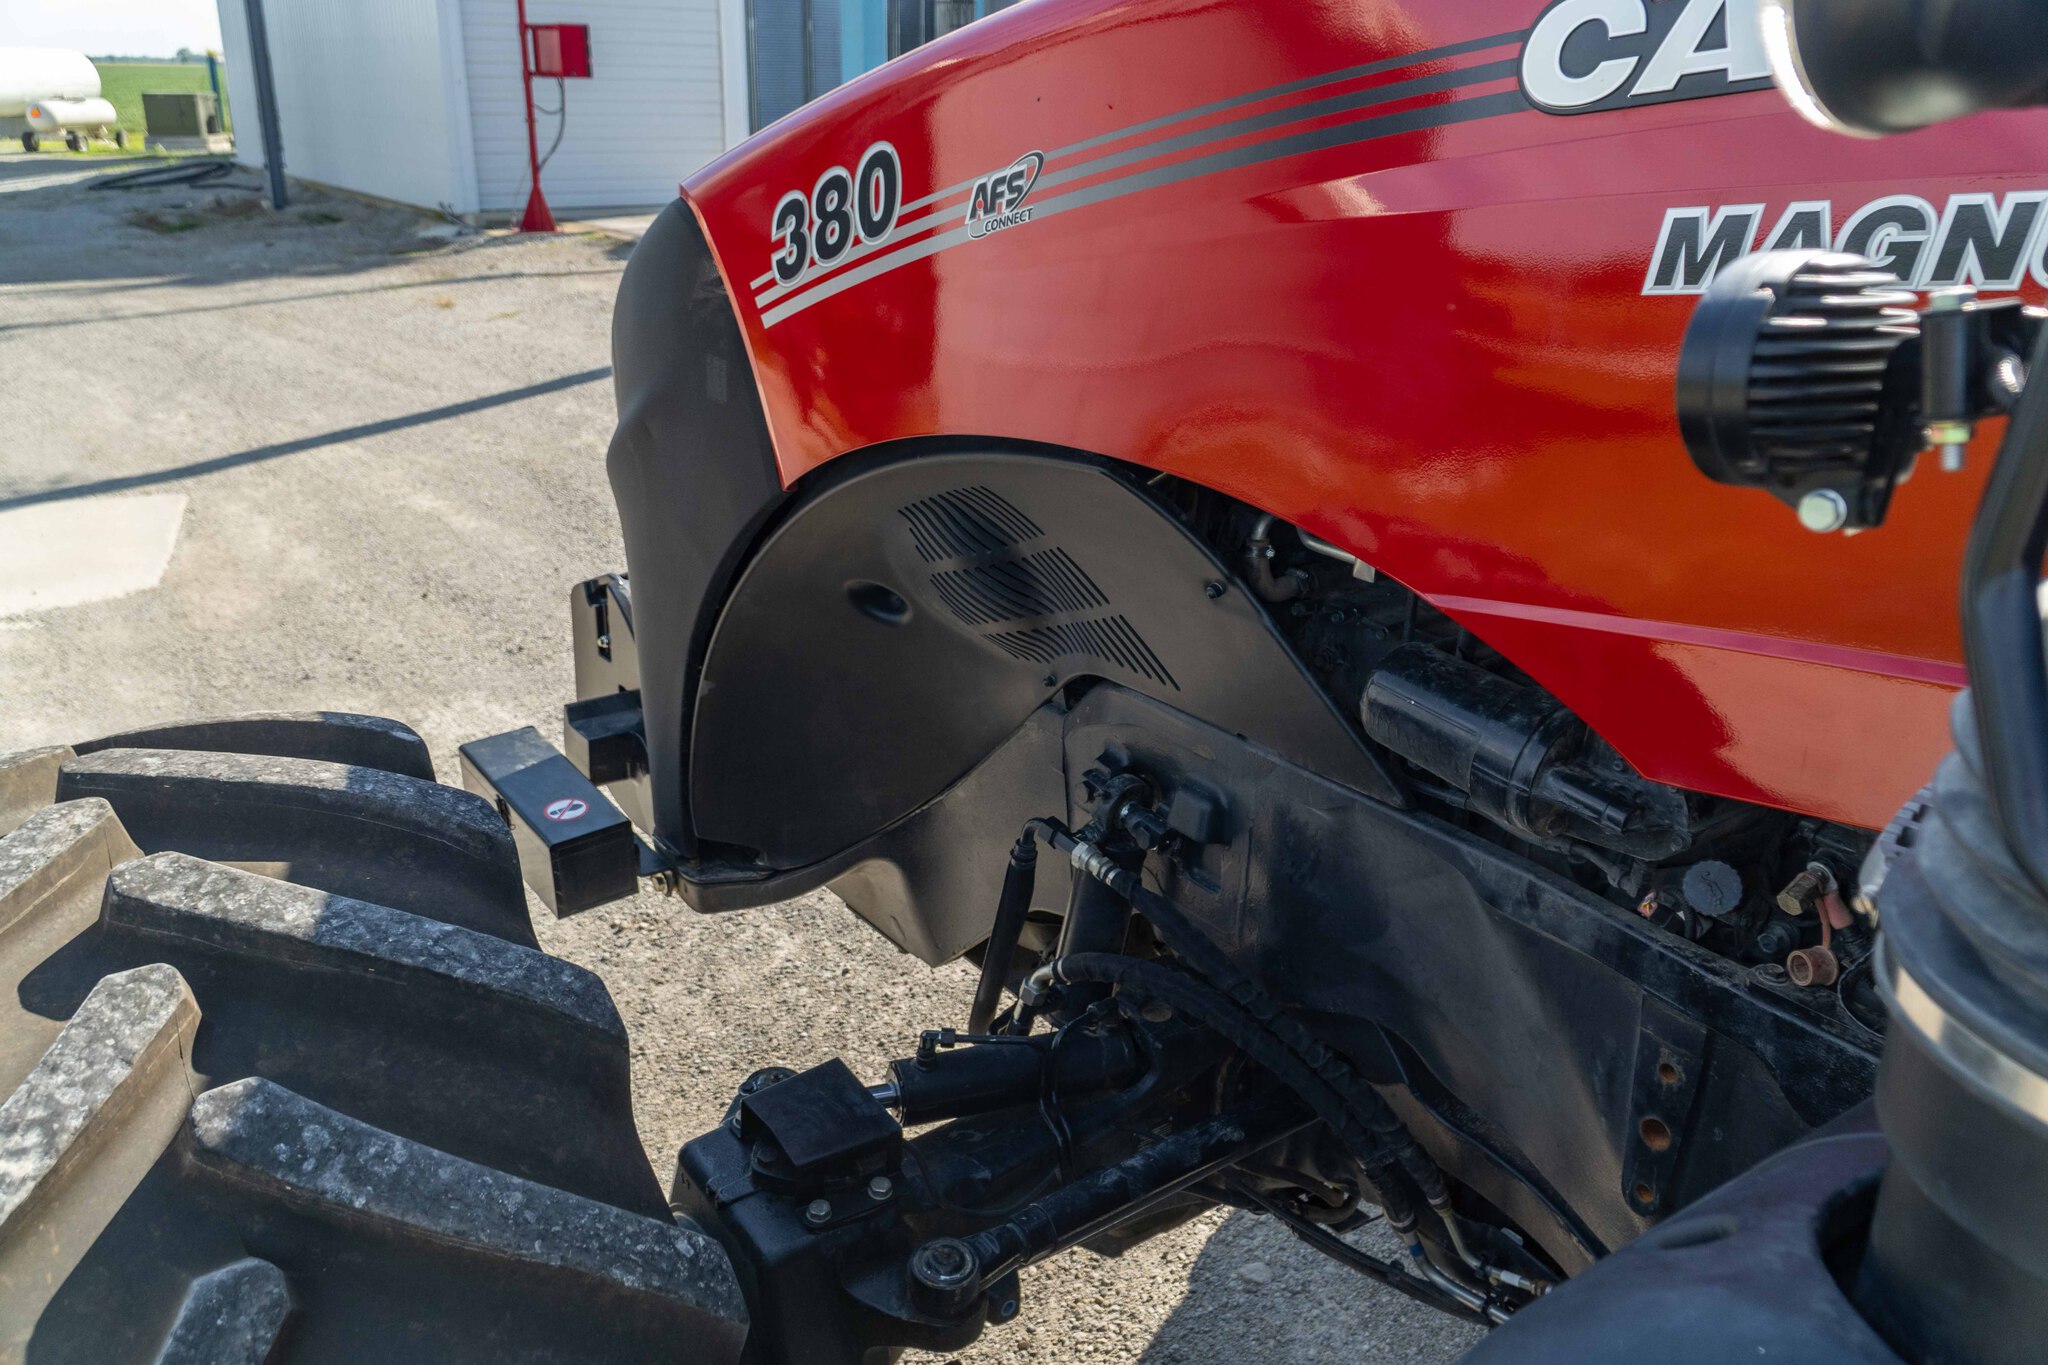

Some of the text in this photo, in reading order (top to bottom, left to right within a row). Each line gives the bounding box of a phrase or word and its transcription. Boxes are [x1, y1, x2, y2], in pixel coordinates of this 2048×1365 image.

[771, 141, 902, 287] 380
[966, 164, 1027, 224] AFS
[984, 206, 1034, 233] CONNECT
